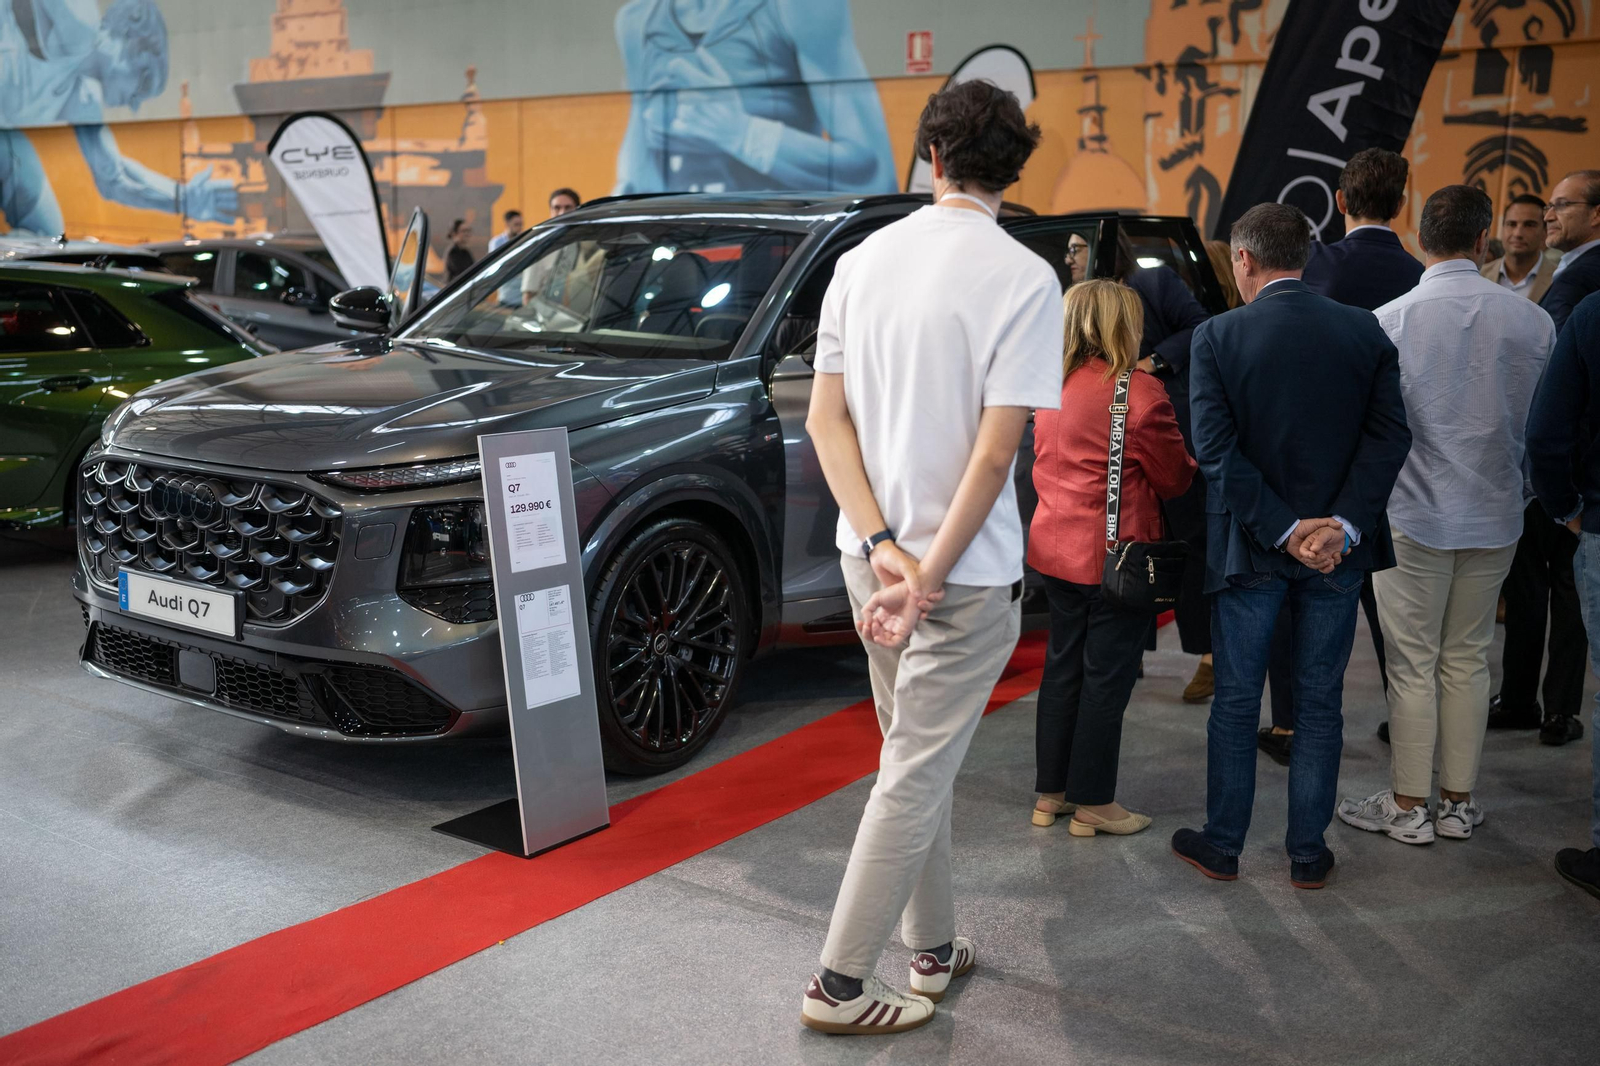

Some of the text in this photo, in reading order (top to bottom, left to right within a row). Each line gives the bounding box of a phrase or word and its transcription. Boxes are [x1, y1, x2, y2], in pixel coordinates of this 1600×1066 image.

[508, 483, 521, 493] Q7
[510, 501, 545, 513] 129.990
[148, 589, 211, 619] Audi Q7
